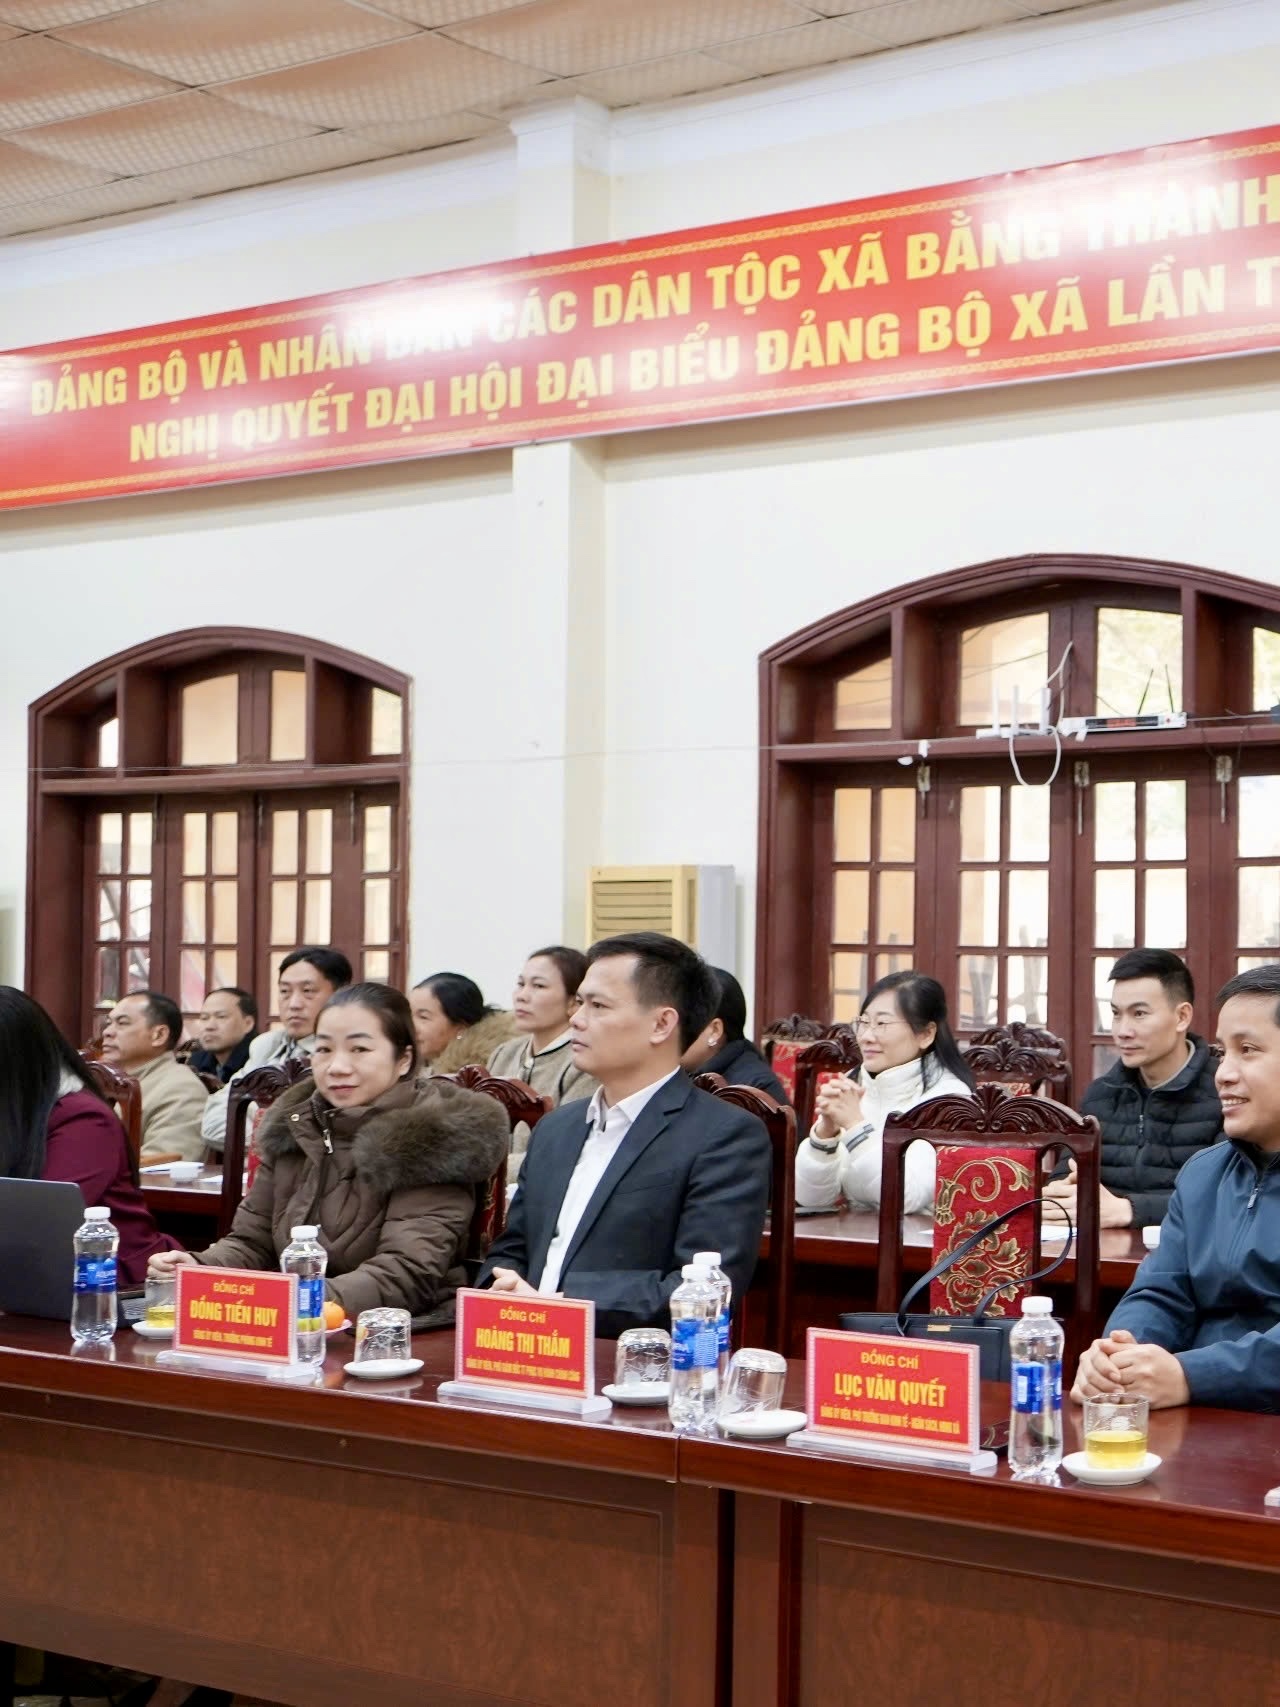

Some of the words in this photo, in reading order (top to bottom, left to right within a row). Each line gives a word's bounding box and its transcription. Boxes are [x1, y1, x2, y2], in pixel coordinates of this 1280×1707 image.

[31, 362, 127, 417] ĐẢNG
[138, 349, 187, 401] BỘ
[199, 339, 247, 388] VÀ
[260, 324, 372, 381] NHÂN
[384, 302, 473, 360] DN
[488, 287, 578, 344] CÁC
[592, 270, 691, 328] DÂN
[706, 252, 801, 315] TỘC
[817, 231, 889, 294] XÃ
[906, 210, 1061, 280] BẰNG
[130, 411, 219, 463] NGHỊ
[232, 383, 353, 449] QUYẾT
[364, 386, 434, 434] ĐẠI
[449, 361, 522, 424] HỘI
[536, 353, 613, 409] ĐẠI
[629, 322, 739, 393] BIỂU
[755, 310, 900, 374] ĐẢNG
[918, 291, 992, 356] BỘ
[1009, 275, 1088, 342] XÃ
[1107, 255, 1225, 328] LẦN
[225, 1299, 252, 1325] TIẾN
[254, 1306, 279, 1328] HUY
[529, 1310, 547, 1324] CHÍ
[476, 1325, 514, 1352] HOÀNG
[517, 1332, 535, 1359] THỊ
[897, 1354, 919, 1370] CHÍ
[834, 1372, 863, 1400] LỤC
[866, 1373, 896, 1401] VĂN
[900, 1377, 947, 1408] QUYẾT
